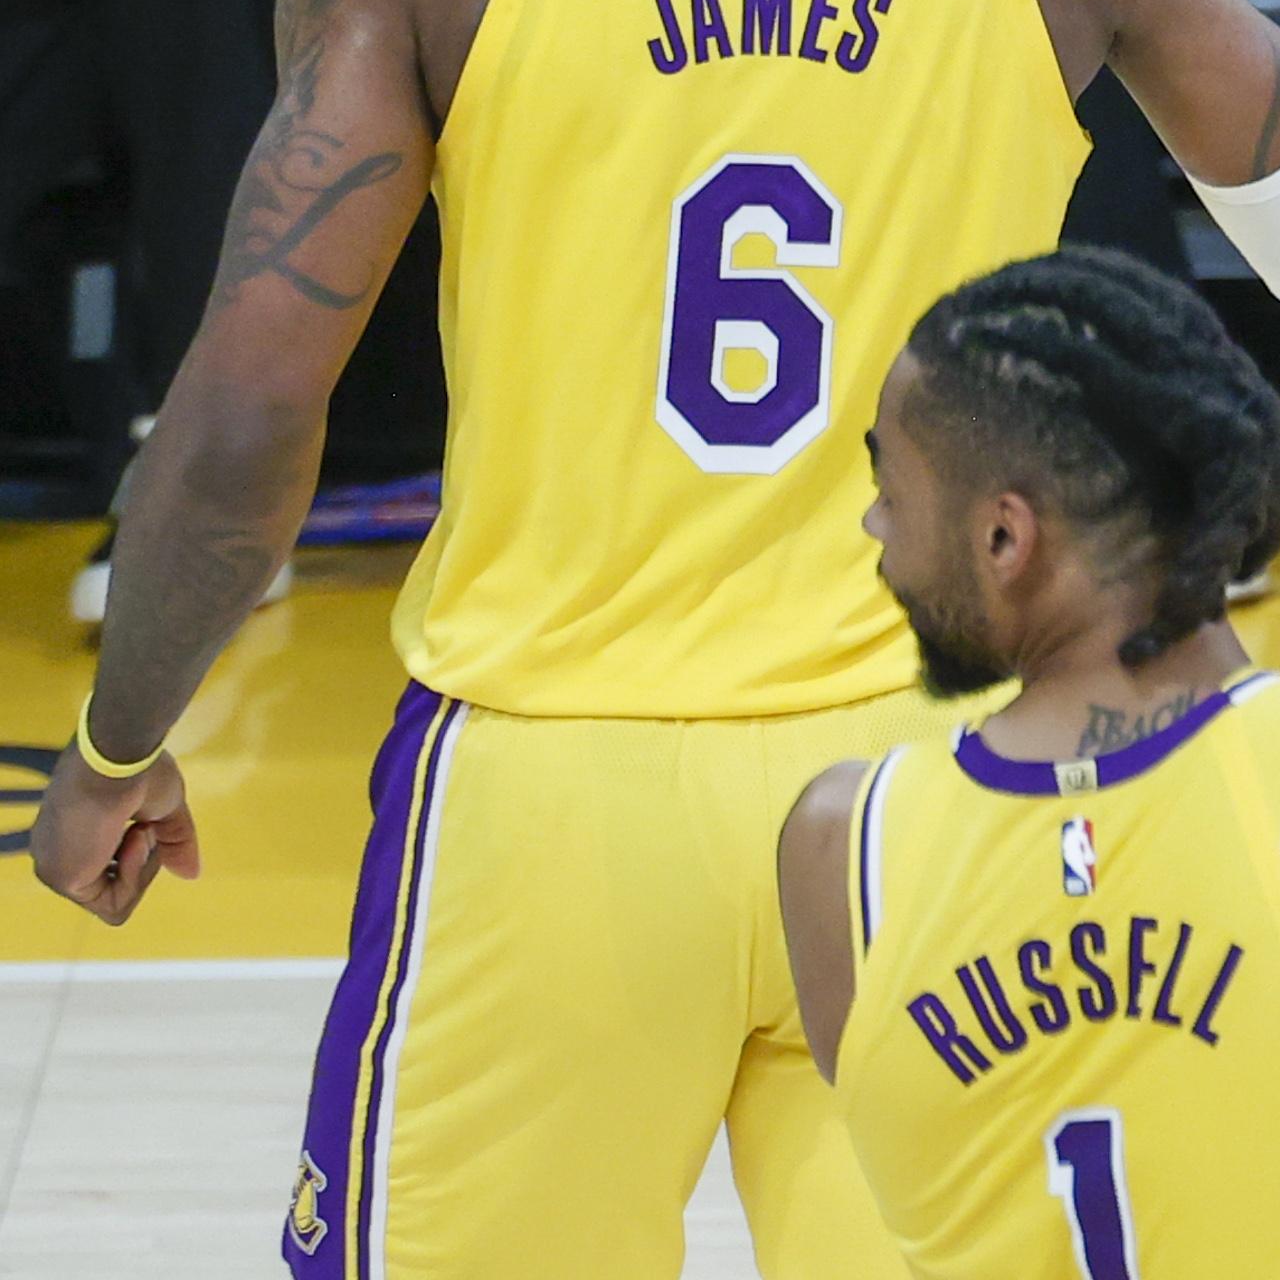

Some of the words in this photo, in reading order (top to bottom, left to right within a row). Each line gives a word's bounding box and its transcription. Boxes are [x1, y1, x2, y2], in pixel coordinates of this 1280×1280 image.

[655, 153, 843, 475] 6
[906, 916, 1244, 1087] RUSSELL
[1043, 1106, 1141, 1280] 1
